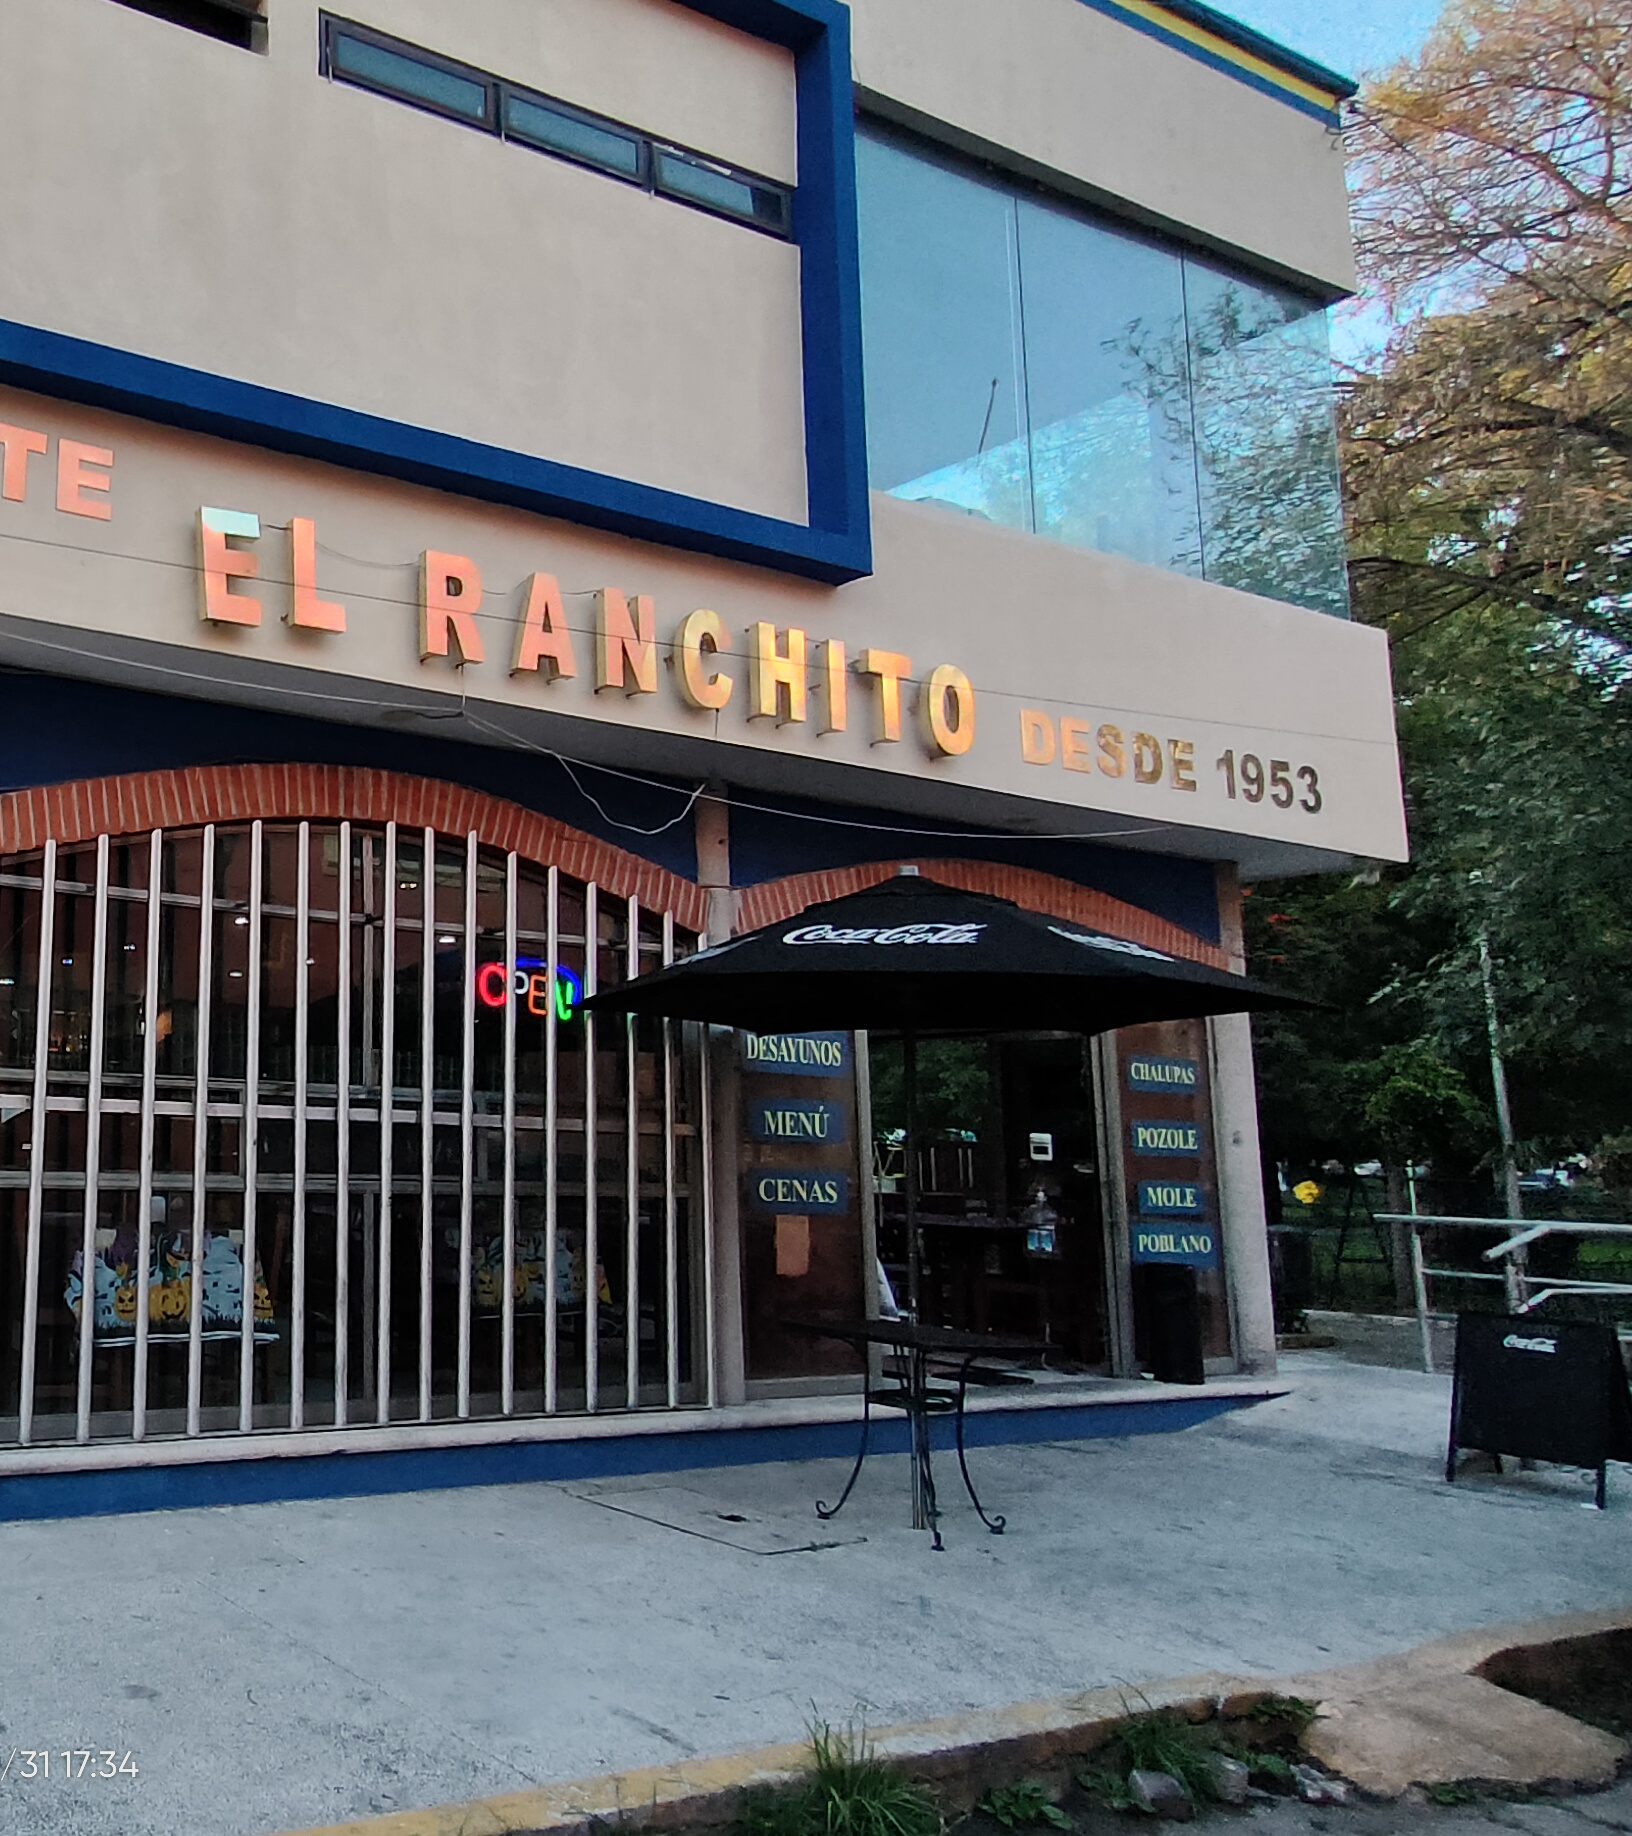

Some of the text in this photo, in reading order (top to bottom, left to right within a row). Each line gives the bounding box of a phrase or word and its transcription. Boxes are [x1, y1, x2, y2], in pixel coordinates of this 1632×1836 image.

[193, 505, 976, 759] EL RANCHITO
[1020, 707, 1324, 816] DESDE 1953
[782, 922, 989, 947] Coca-Cola
[477, 961, 574, 1022] OPEN
[746, 1032, 843, 1068] DESAYUNOS
[1130, 1062, 1196, 1086] CHALUPAS
[764, 1106, 830, 1139] MENÚ
[1137, 1127, 1198, 1151] POZOLE
[759, 1177, 838, 1205] CENAS
[1147, 1187, 1197, 1209] MOLE
[1138, 1232, 1212, 1255] POBLANO
